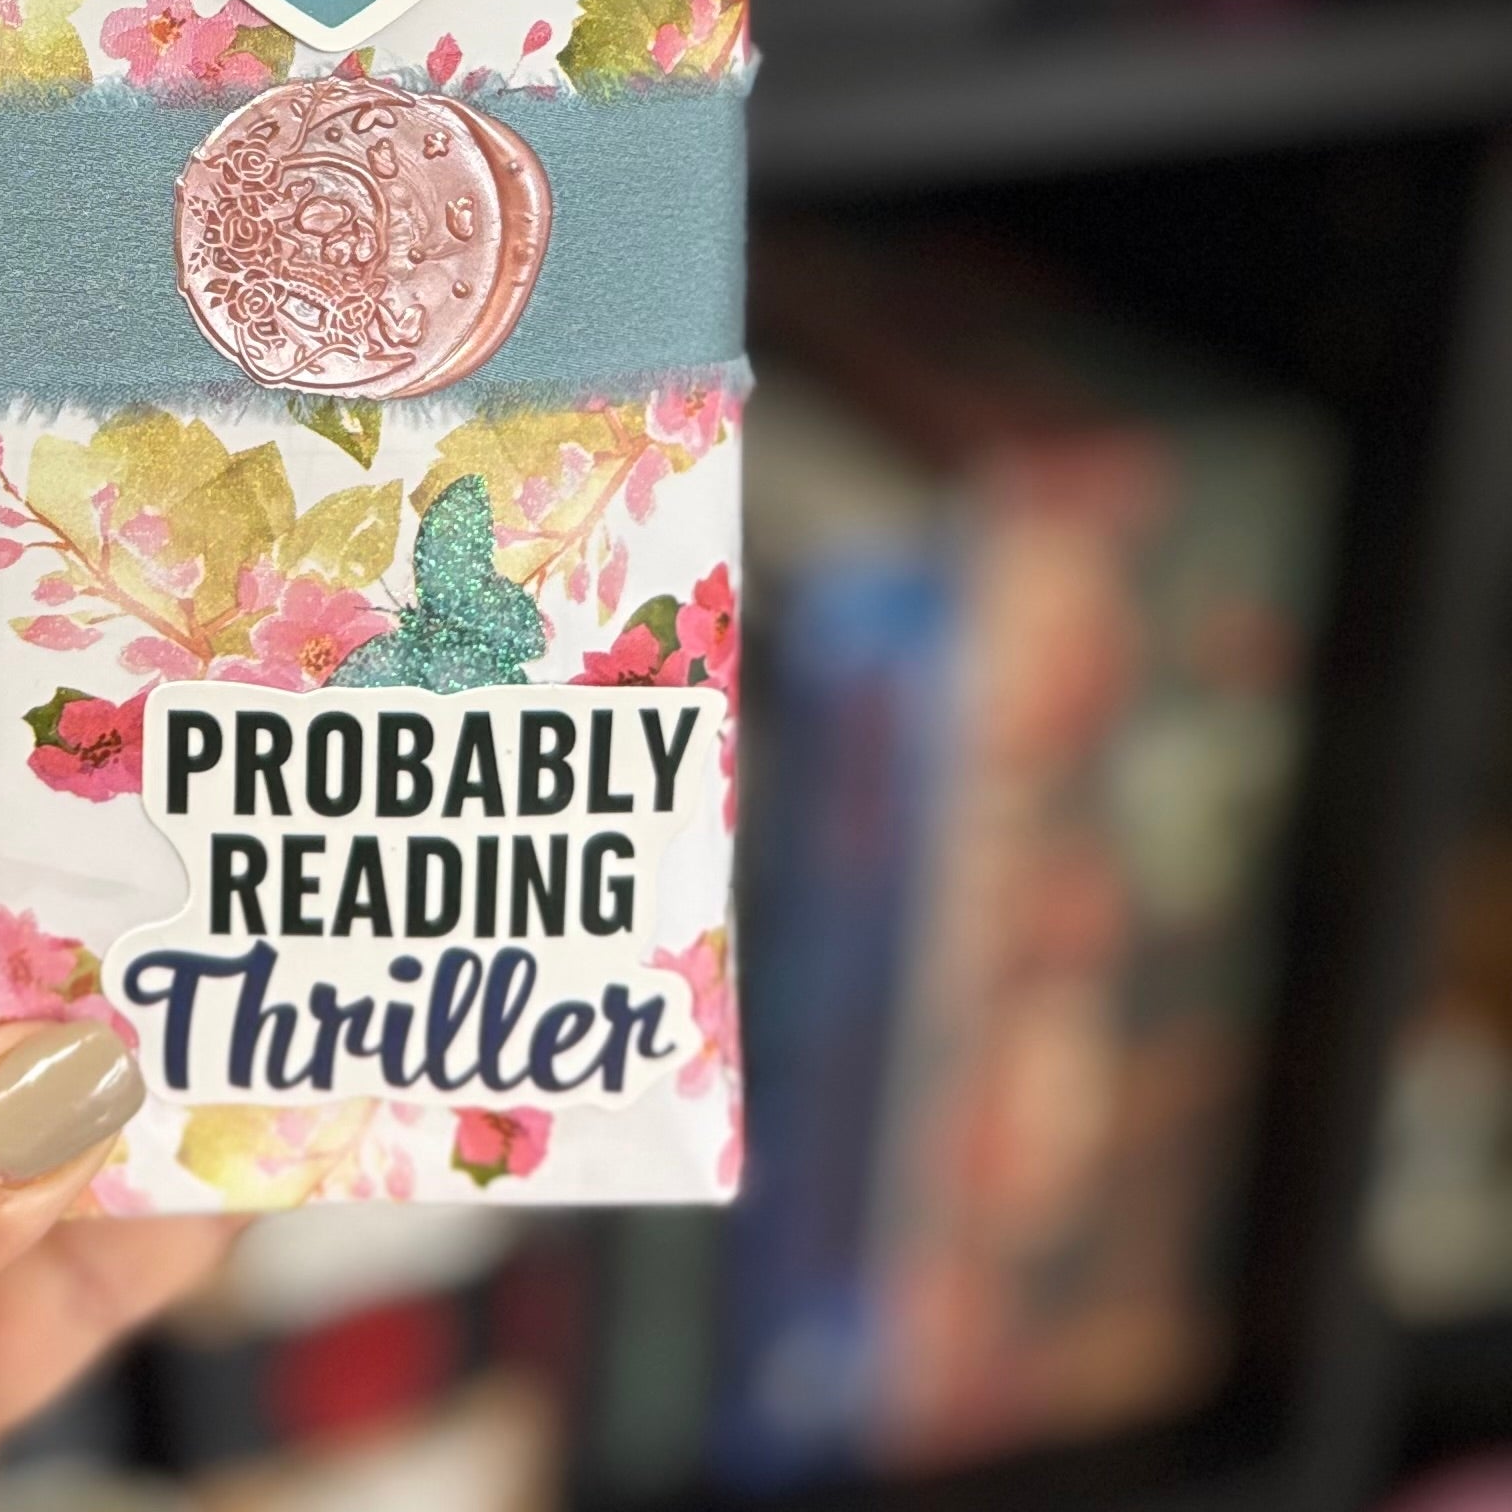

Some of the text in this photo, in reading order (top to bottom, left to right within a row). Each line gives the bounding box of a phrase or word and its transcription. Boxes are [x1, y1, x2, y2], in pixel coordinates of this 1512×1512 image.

[165, 705, 701, 819] PROBABLY
[208, 830, 637, 939] READING
[122, 938, 677, 1094] Thriller
